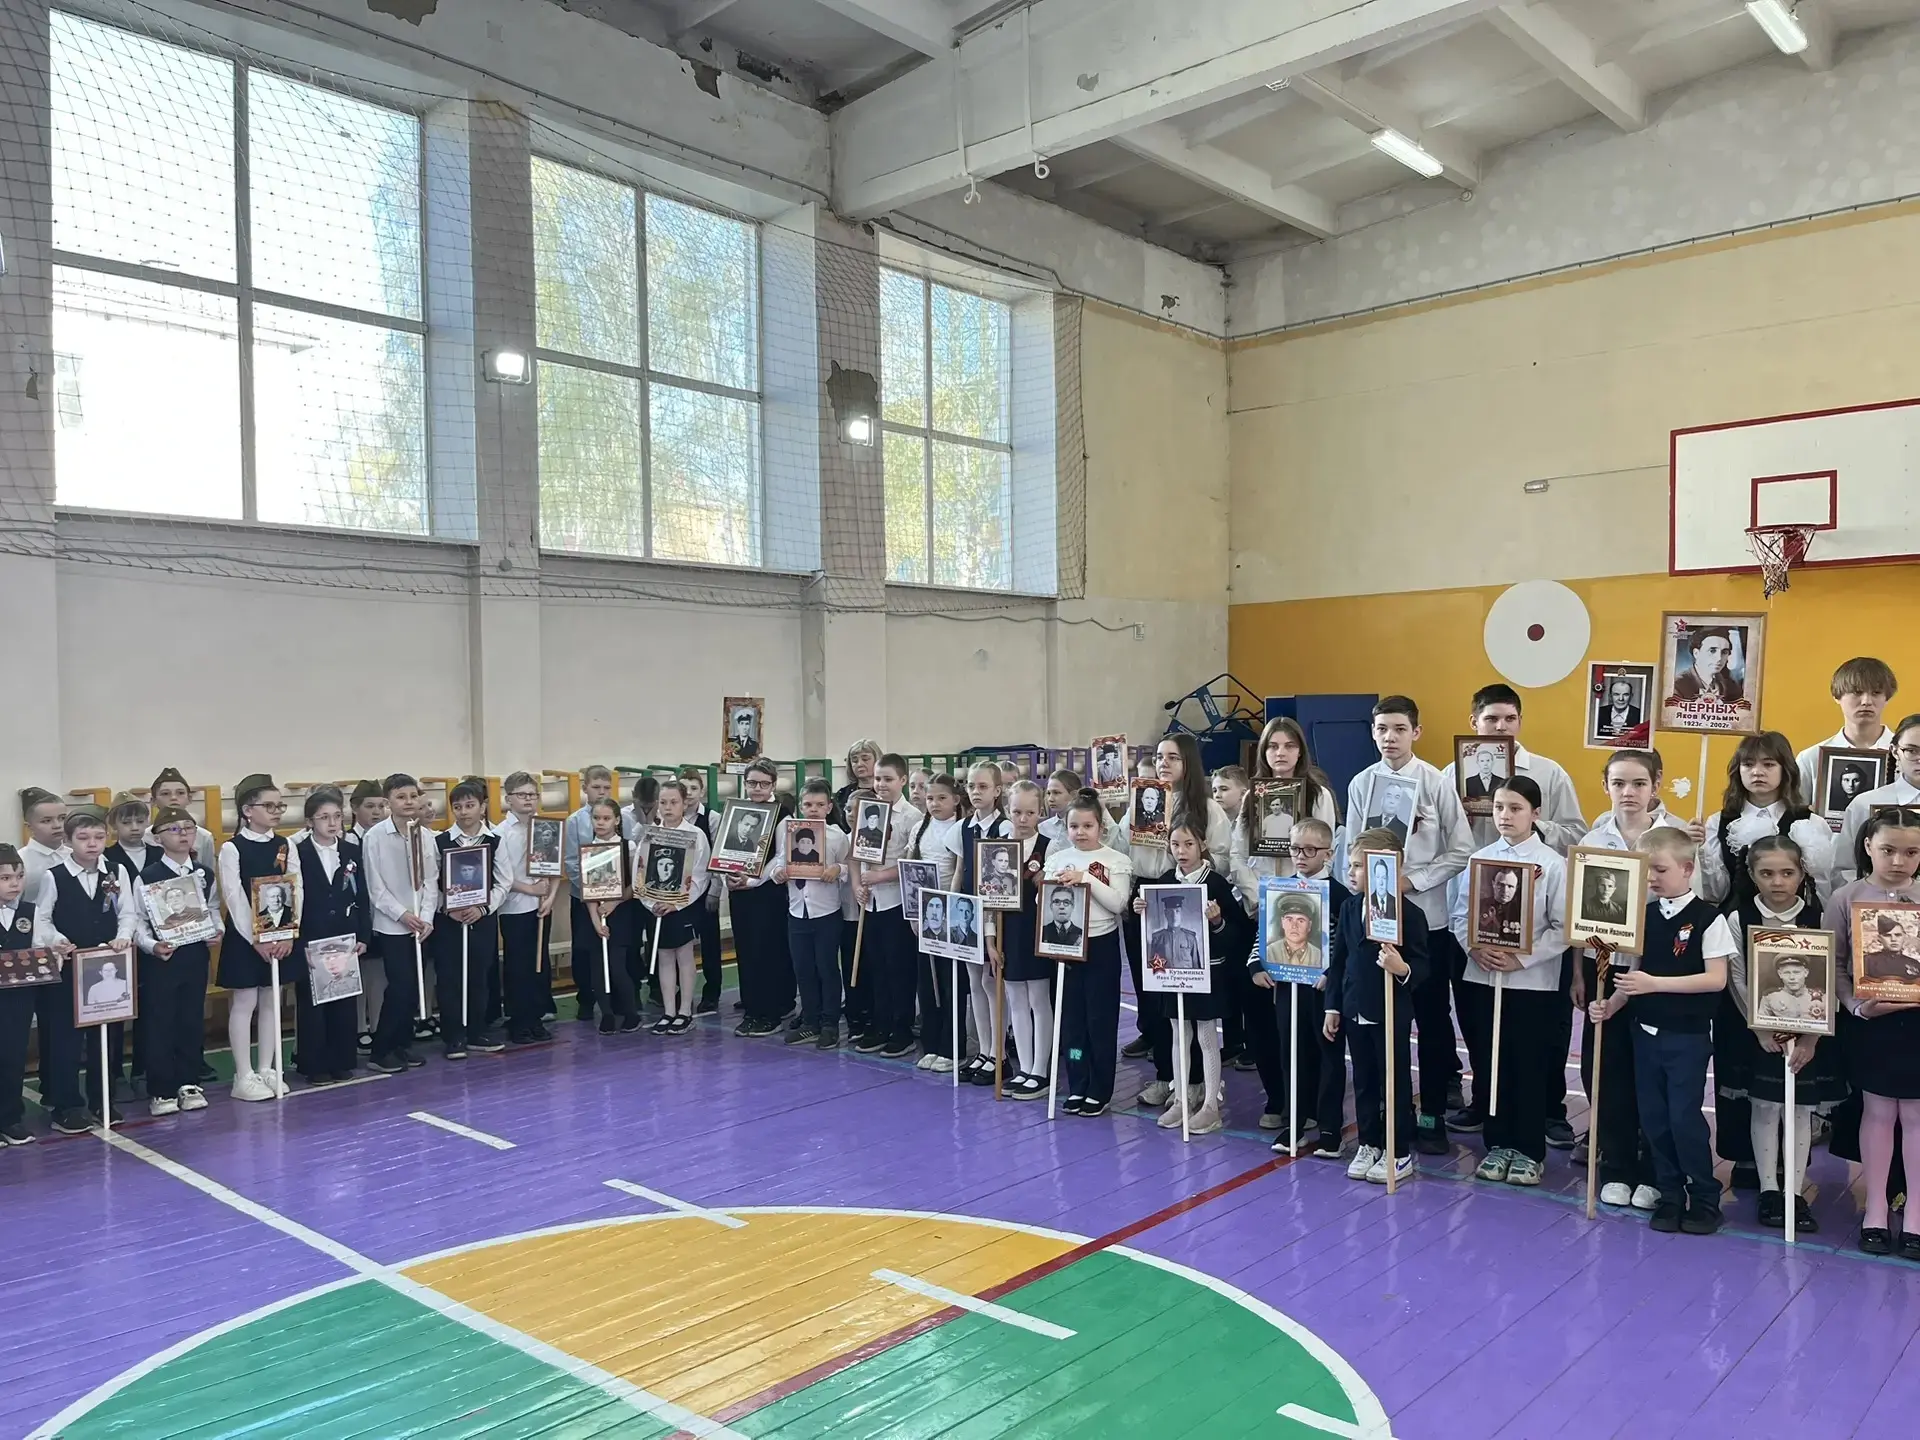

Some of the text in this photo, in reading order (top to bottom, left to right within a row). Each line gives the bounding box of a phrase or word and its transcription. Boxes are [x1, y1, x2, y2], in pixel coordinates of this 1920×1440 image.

[1680, 702, 1737, 714] ЧЕРНЫХ
[1701, 713, 1740, 722] Кузьмич
[1609, 928, 1635, 938] Иванович
